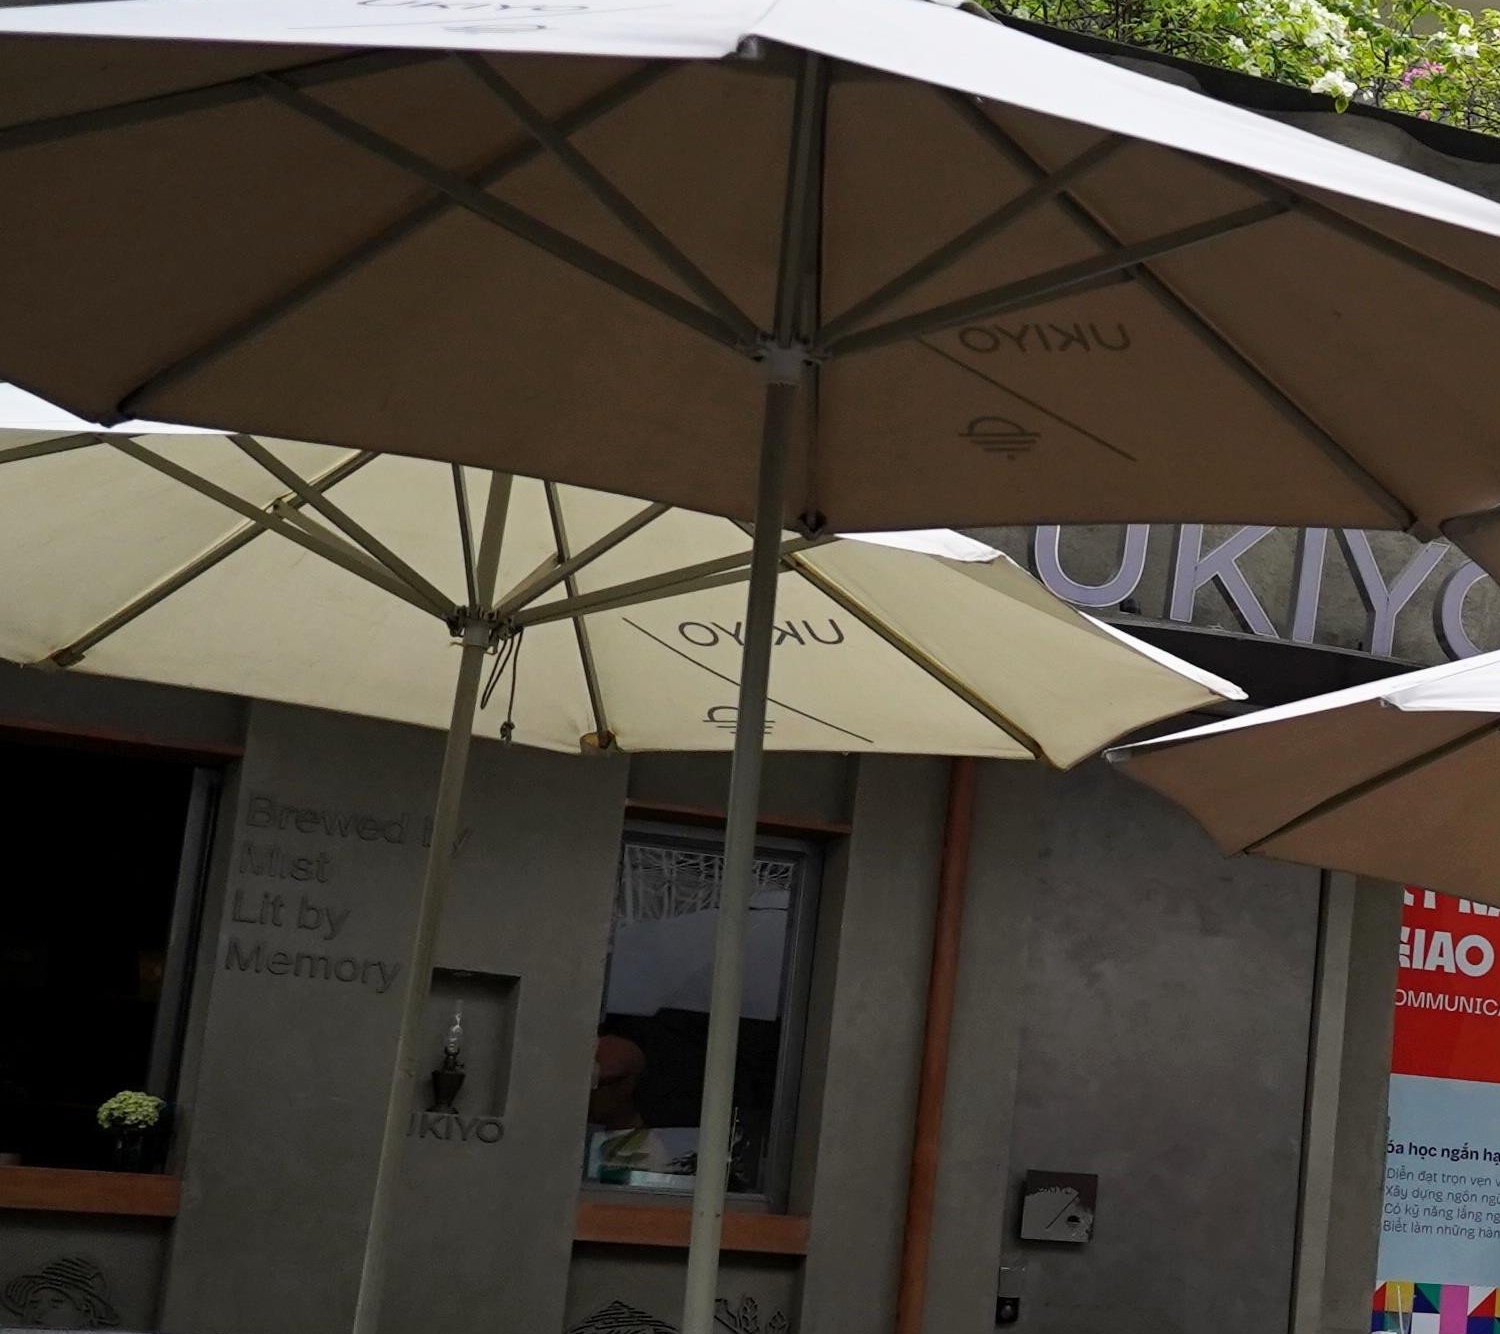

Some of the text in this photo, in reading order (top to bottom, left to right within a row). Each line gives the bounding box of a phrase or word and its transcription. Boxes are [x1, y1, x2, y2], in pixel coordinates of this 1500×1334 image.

[246, 796, 410, 845] Brewed
[232, 888, 350, 941] Lit by
[224, 937, 402, 994] Memory
[1387, 1144, 1403, 1154] óa
[1409, 1142, 1437, 1159] học
[1442, 1143, 1478, 1161] ngắn
